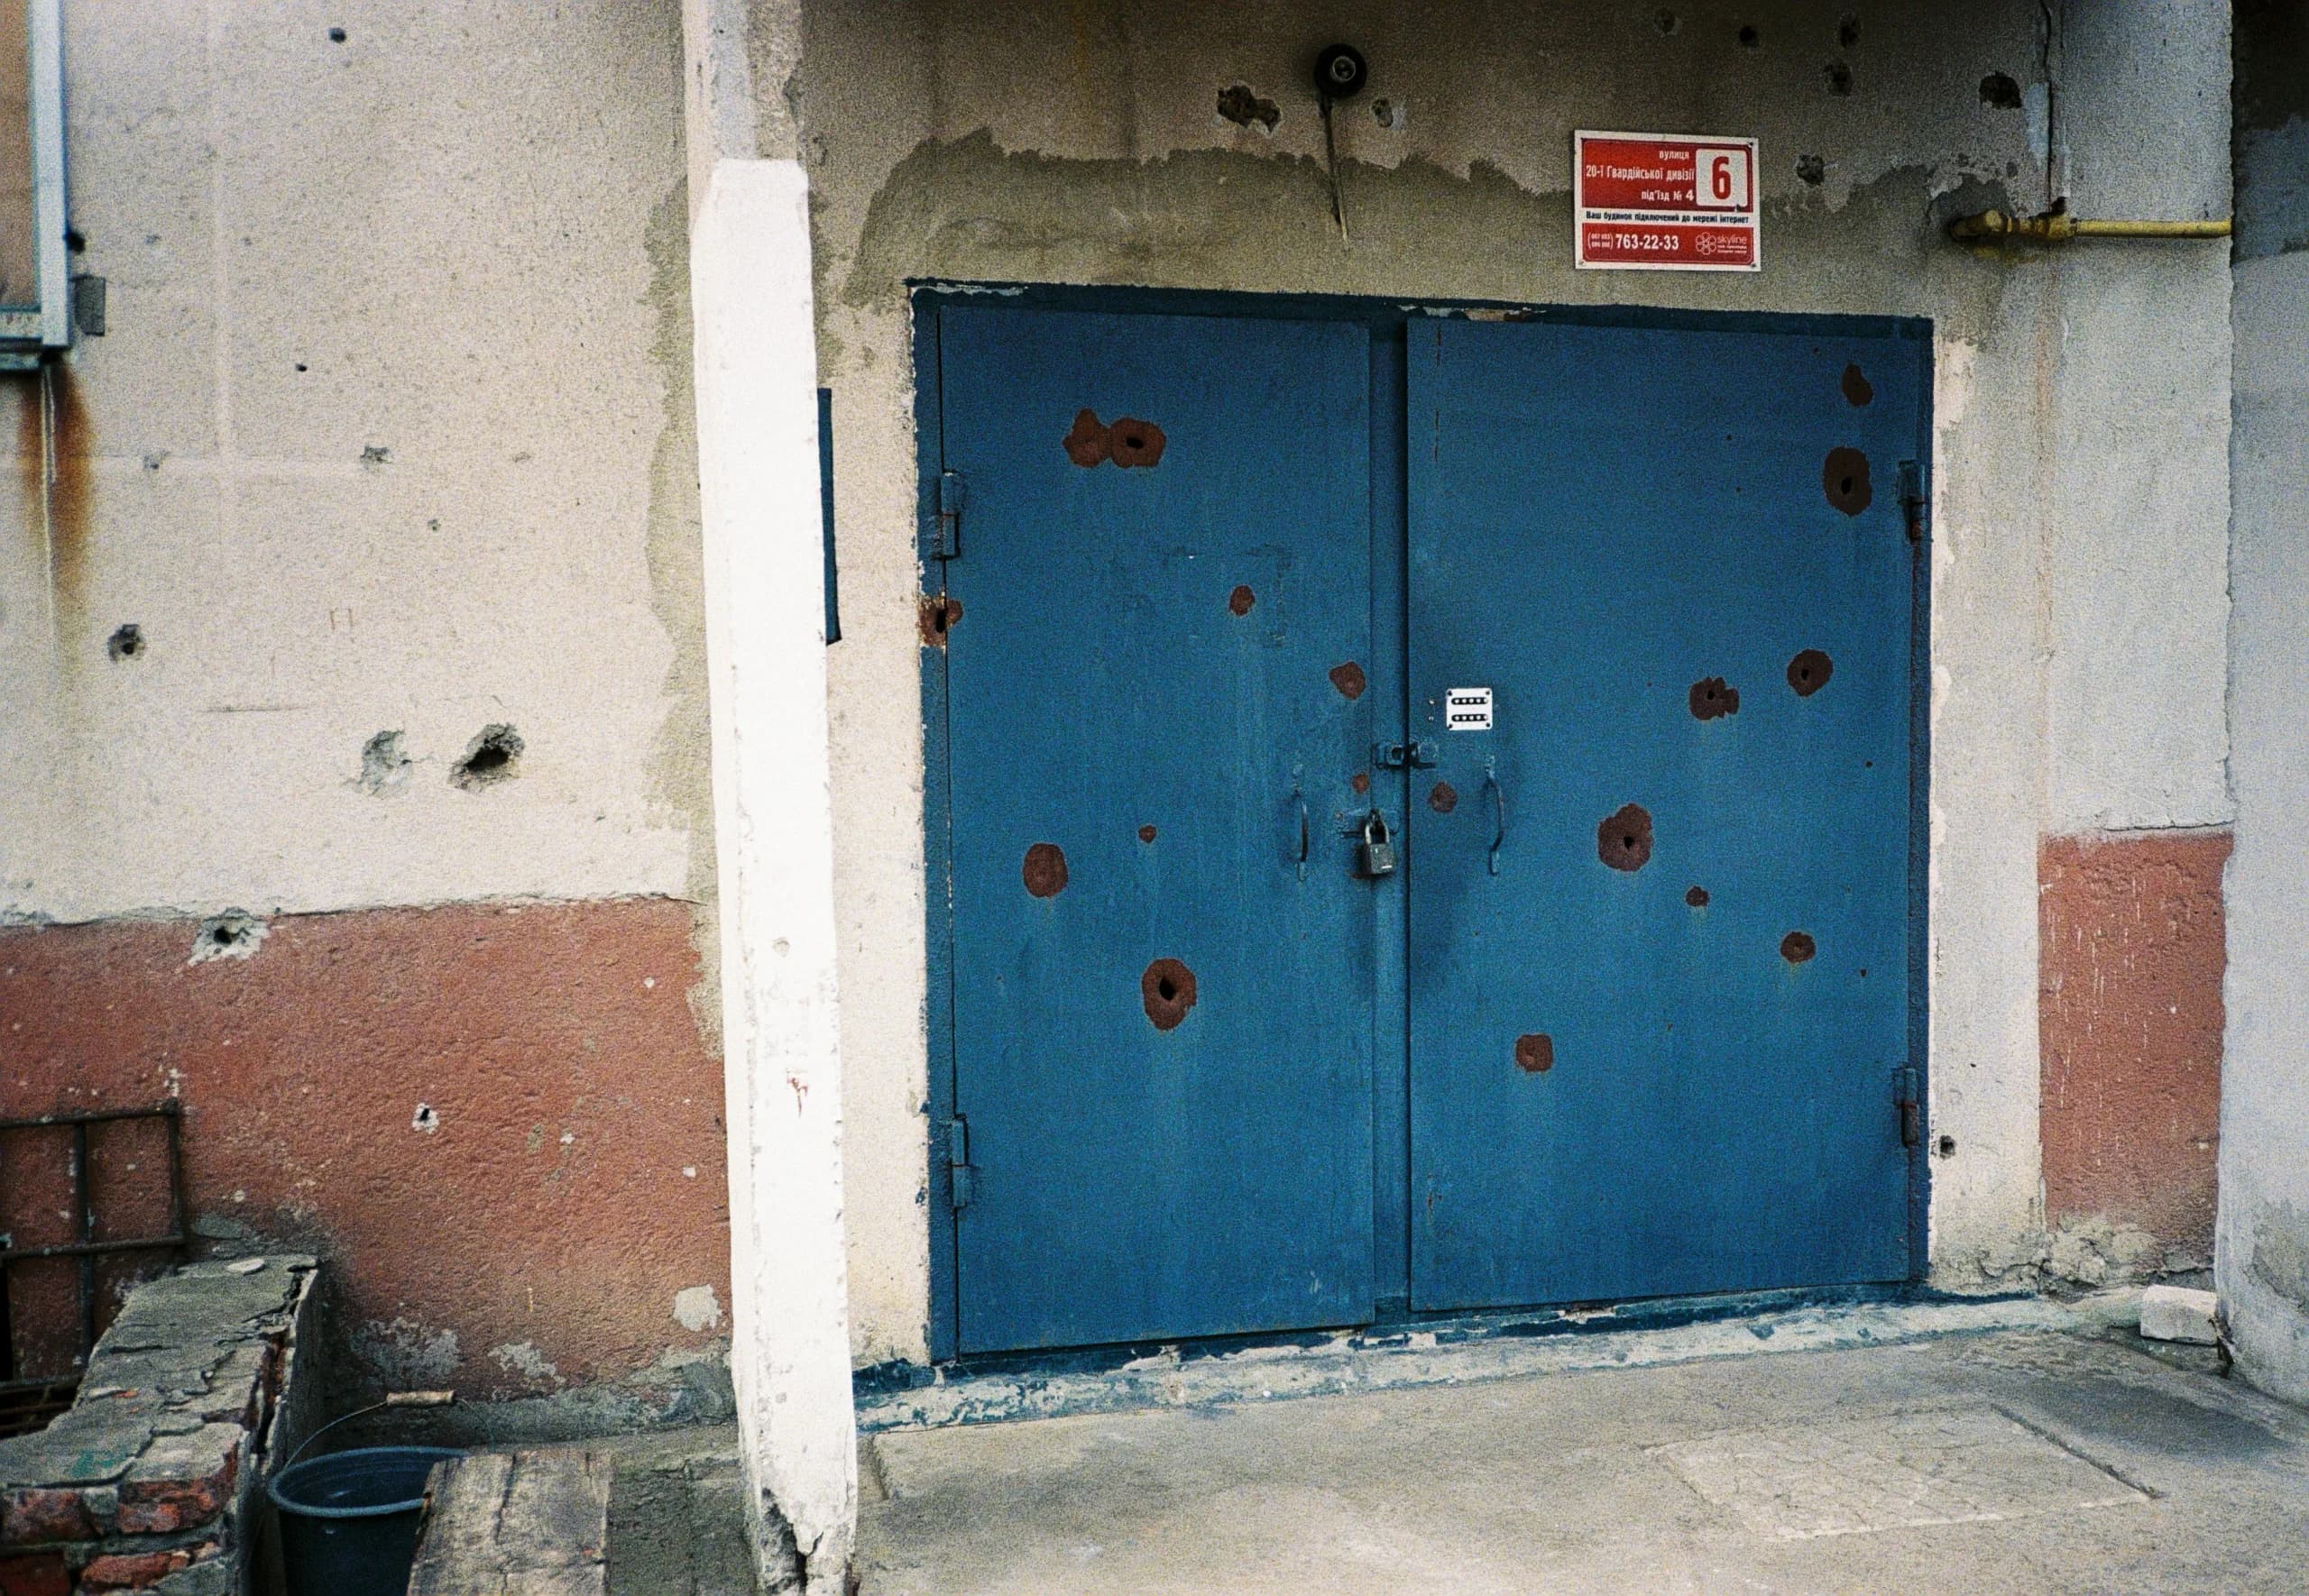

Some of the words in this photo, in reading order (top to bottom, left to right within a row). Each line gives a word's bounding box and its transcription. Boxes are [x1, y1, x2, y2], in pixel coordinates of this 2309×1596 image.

[1659, 150, 1689, 161] вулиця
[1586, 164, 1604, 178] 20-ї
[1606, 165, 1663, 181] Гвардійської
[1666, 167, 1695, 181] дивізії
[1712, 156, 1731, 200] 6
[1685, 189, 1695, 201] 4
[1586, 210, 1602, 219] Ваш
[1604, 211, 1633, 221] будинок
[1634, 212, 1679, 222] підключений
[1681, 215, 1690, 223] до
[1693, 215, 1718, 224] мережі
[1719, 215, 1749, 224] інтернет
[1615, 233, 1679, 251] 763-22-33
[1716, 234, 1747, 245] skyline
